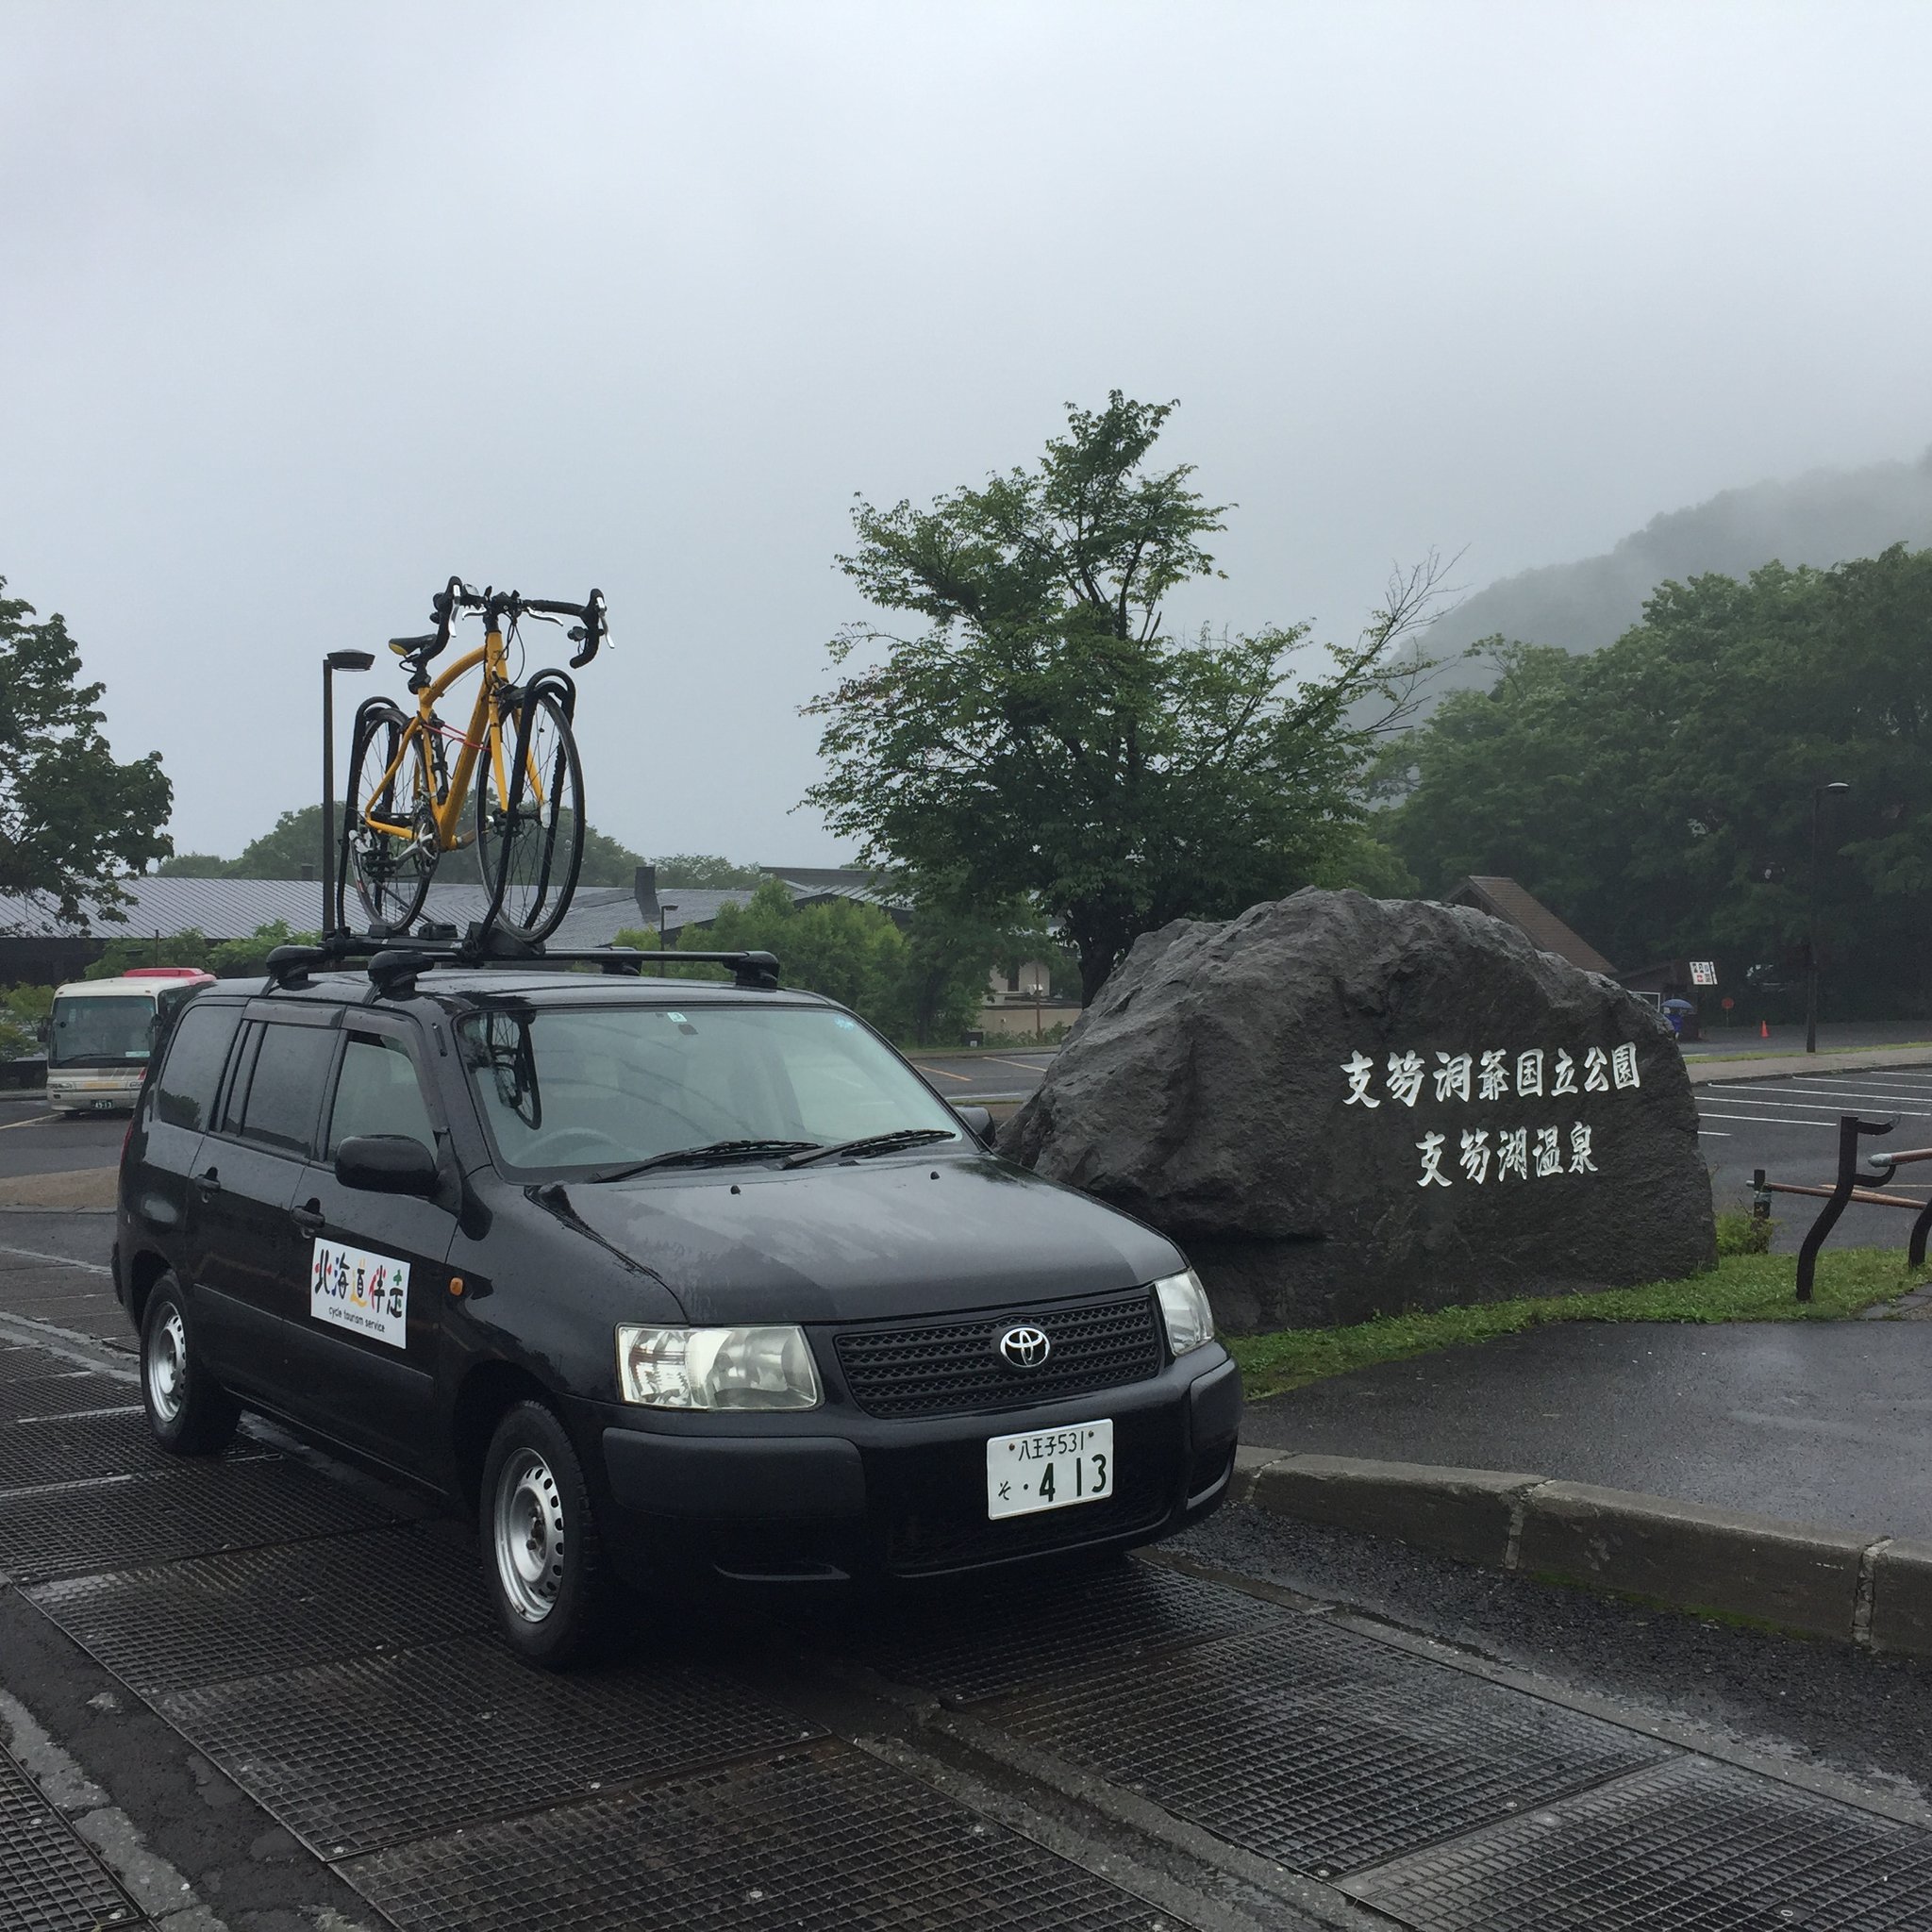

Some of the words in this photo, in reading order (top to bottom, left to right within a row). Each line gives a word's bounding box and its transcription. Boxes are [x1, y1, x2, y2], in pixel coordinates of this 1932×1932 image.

[1415, 1122, 1598, 1187] 支笏湖温泉
[328, 1307, 342, 1319] cycle
[343, 1309, 364, 1325] tourism
[365, 1319, 386, 1333] service
